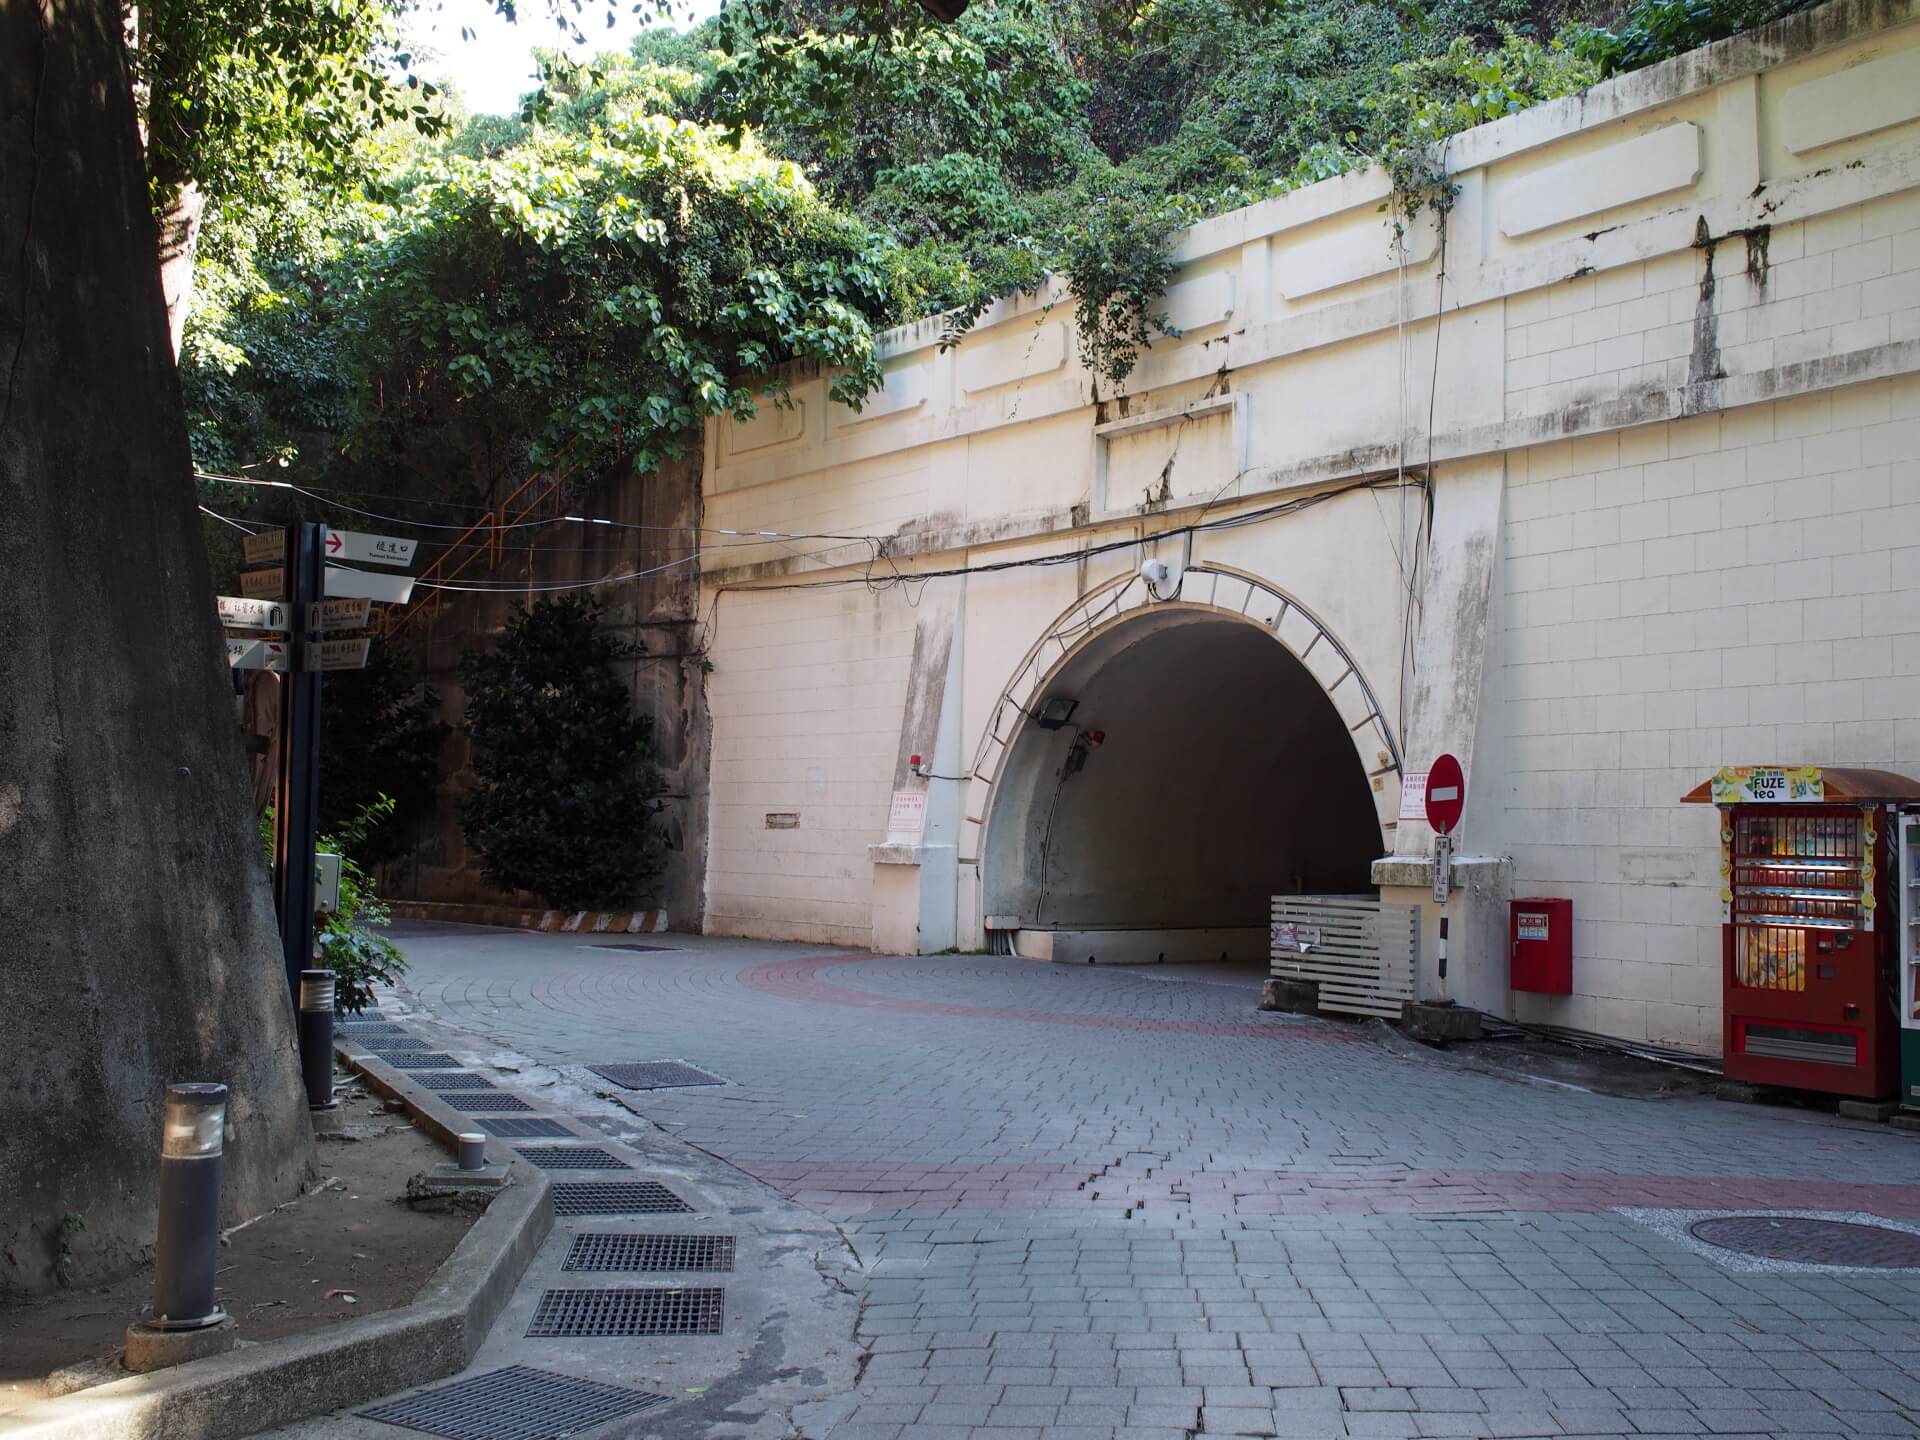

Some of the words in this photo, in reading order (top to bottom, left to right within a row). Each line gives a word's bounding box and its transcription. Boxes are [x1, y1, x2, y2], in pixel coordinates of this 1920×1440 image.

[376, 540, 409, 554] 隧道口
[1754, 778, 1784, 788] FUZE
[1753, 790, 1775, 799] tea
